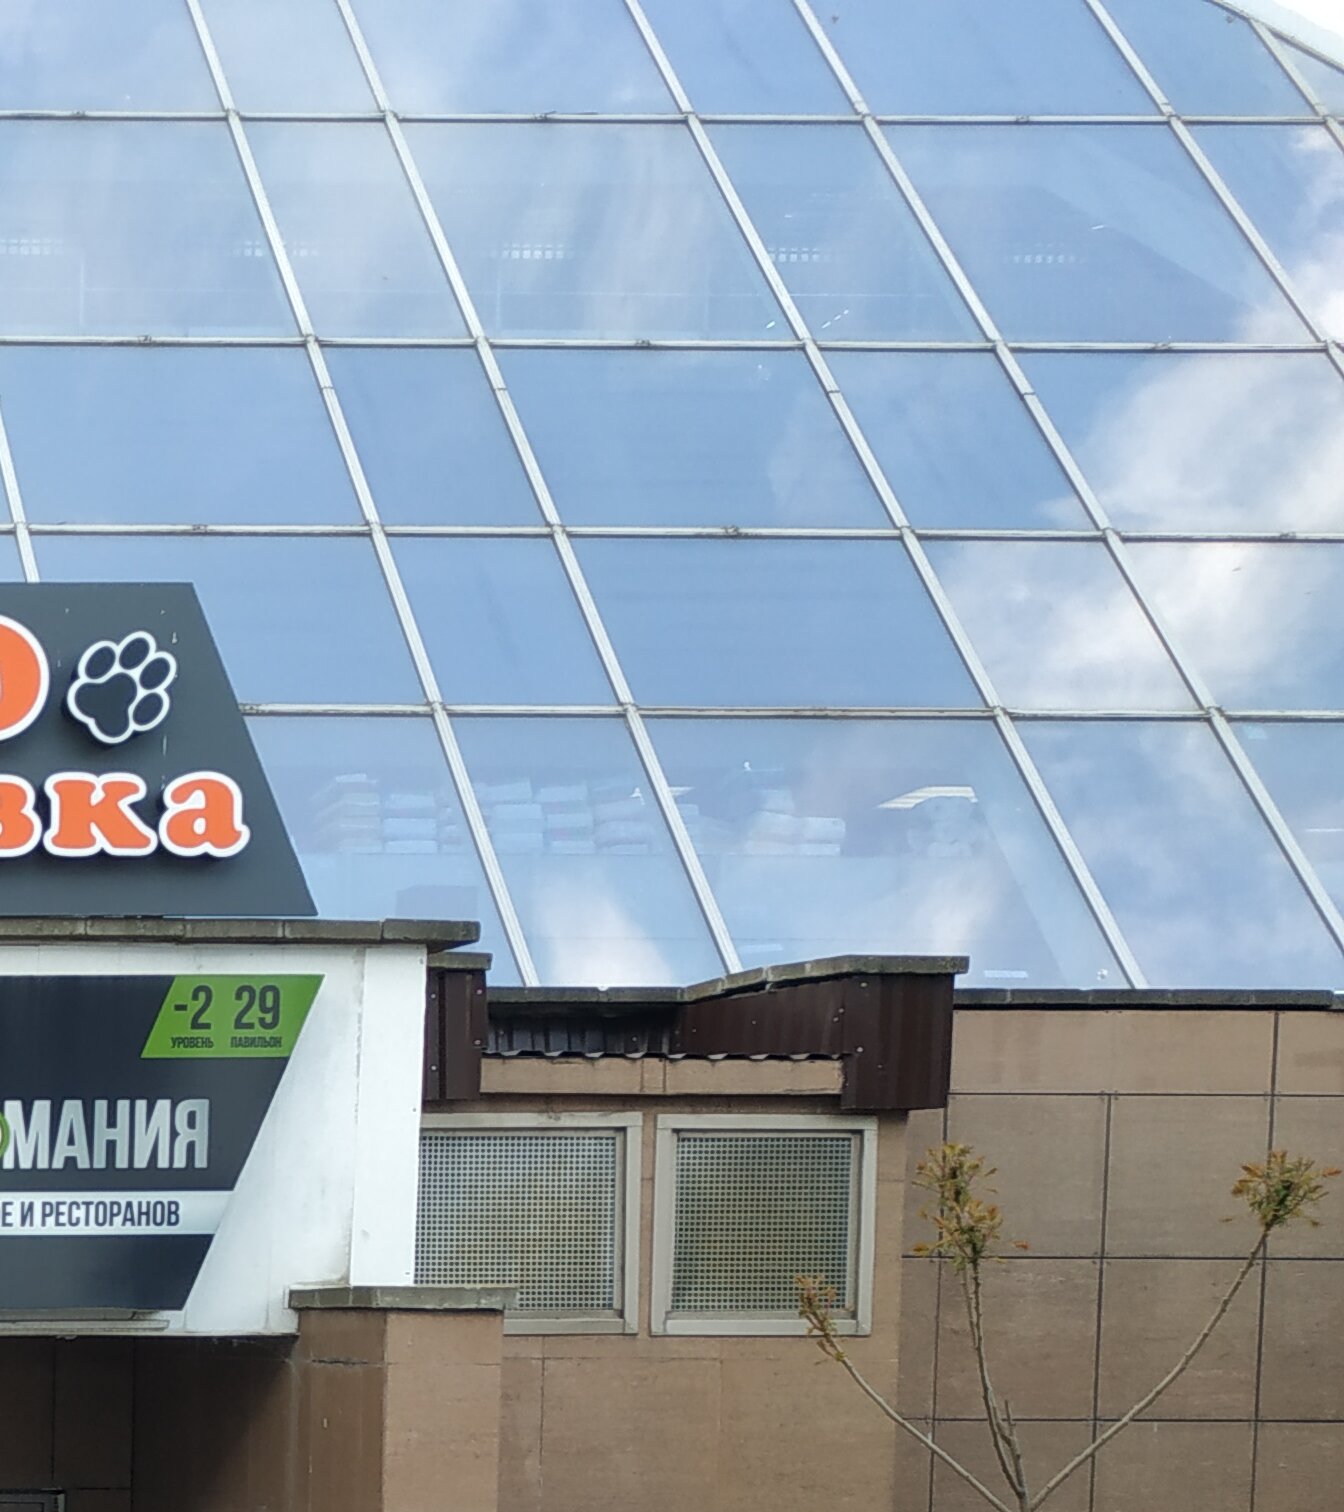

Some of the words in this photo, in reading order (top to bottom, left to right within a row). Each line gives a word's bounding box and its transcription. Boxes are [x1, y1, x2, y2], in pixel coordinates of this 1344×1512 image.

[174, 985, 213, 1030] -2
[234, 985, 281, 1030] 29
[171, 1037, 214, 1049] УРОВЕНЬ
[231, 1037, 282, 1049] ПАВИЛЬОН
[20, 1200, 34, 1227] И
[41, 1200, 180, 1228] РЕСТОРАНОВ
